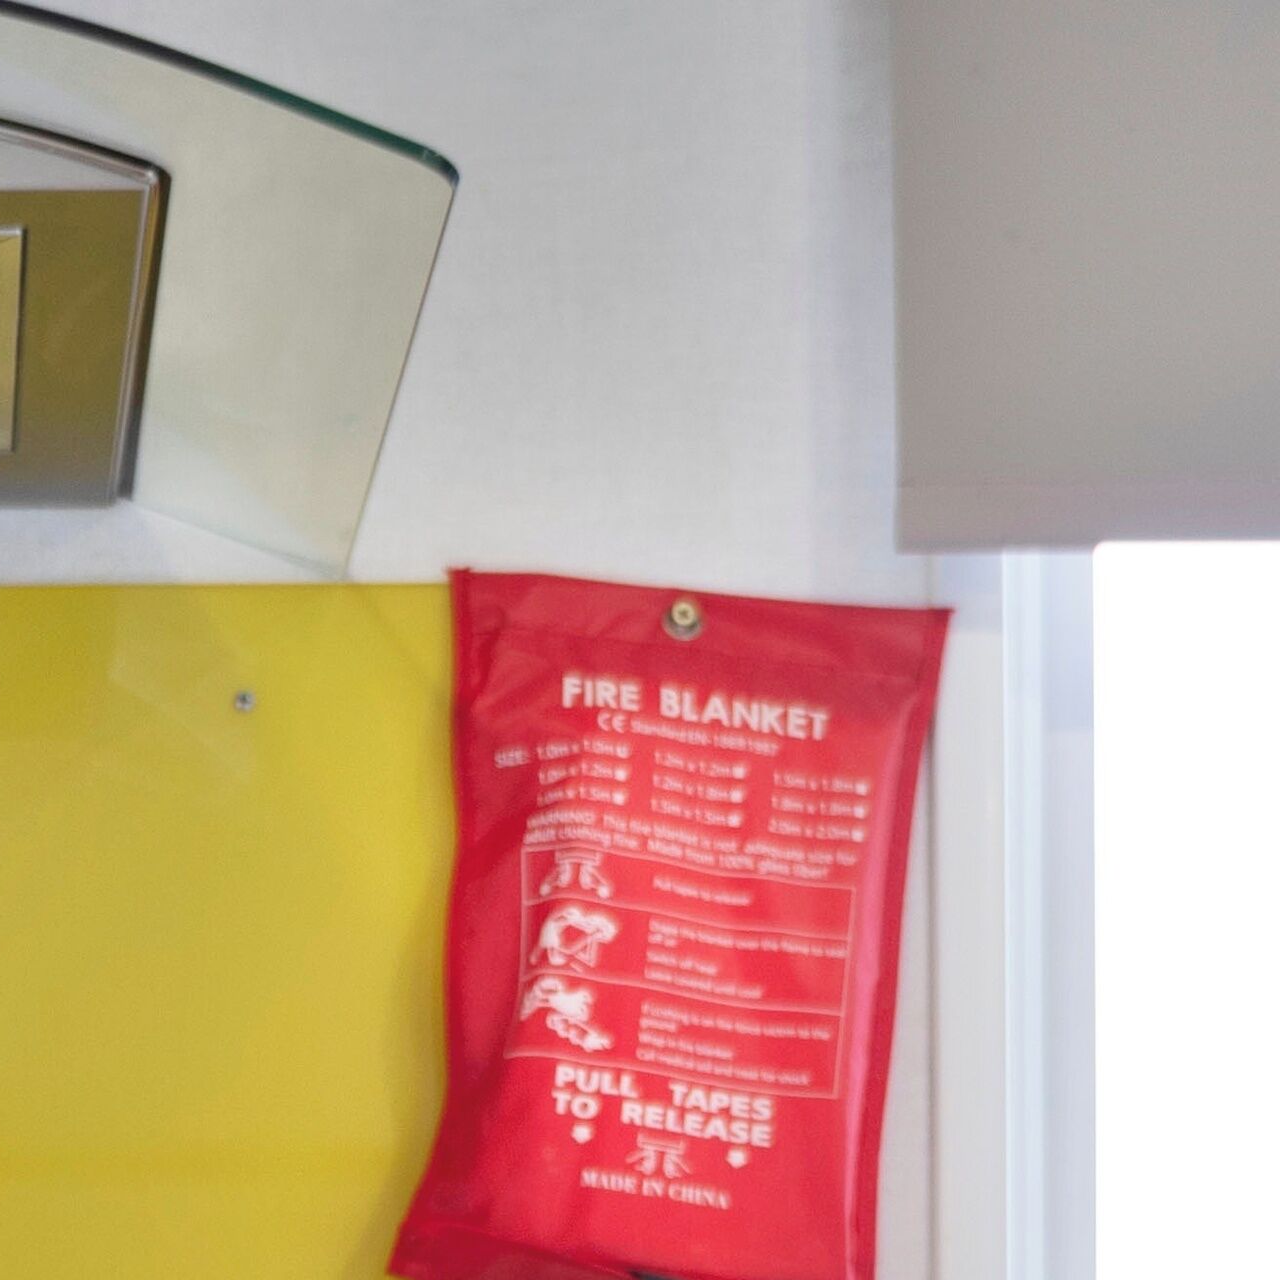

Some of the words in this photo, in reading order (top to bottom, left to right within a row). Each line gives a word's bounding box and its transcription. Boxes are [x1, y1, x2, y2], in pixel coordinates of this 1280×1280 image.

[562, 673, 641, 712] FIRE
[659, 686, 829, 741] BLANKET
[552, 1088, 600, 1119] TO
[621, 1100, 774, 1148] RELEASE
[554, 1064, 638, 1098] PULL
[669, 1080, 774, 1121] TAPES
[581, 1168, 636, 1195] MADE
[642, 1177, 664, 1198] IN
[669, 1182, 730, 1210] CHINA
